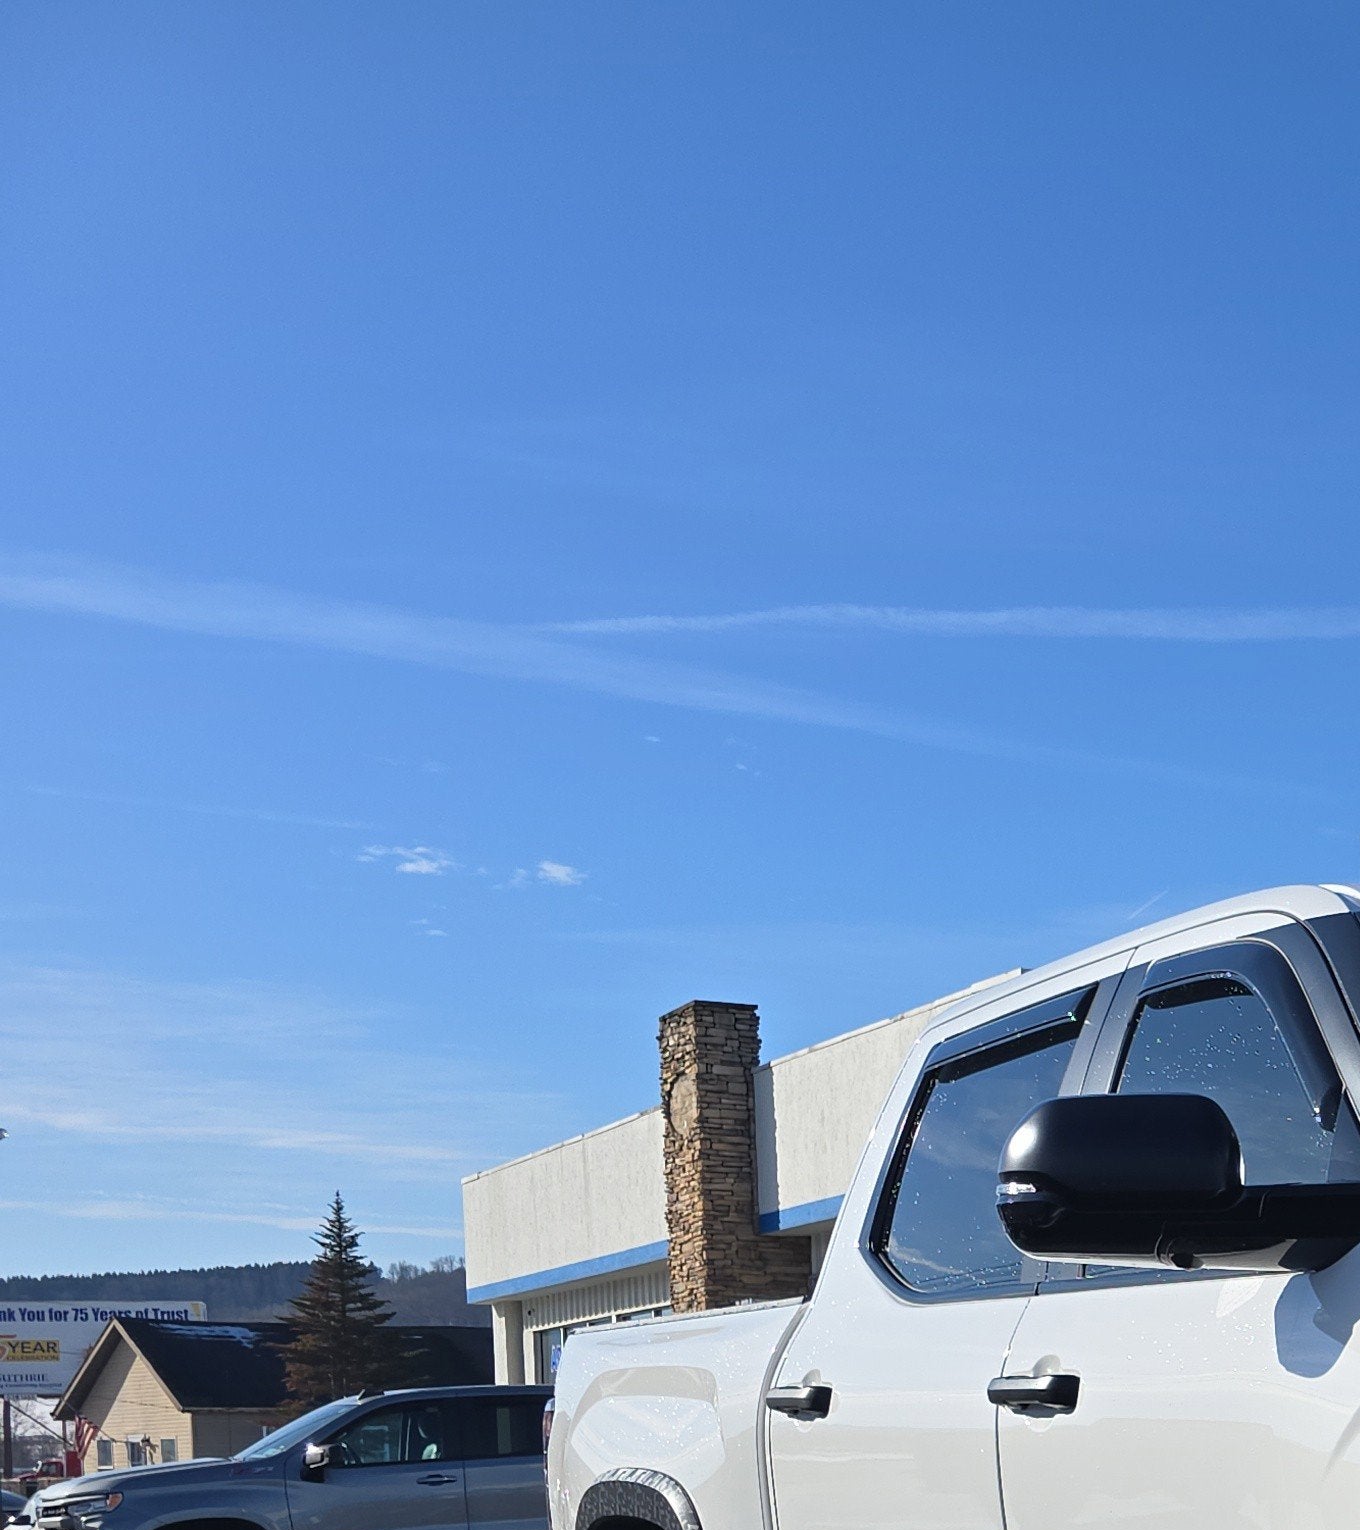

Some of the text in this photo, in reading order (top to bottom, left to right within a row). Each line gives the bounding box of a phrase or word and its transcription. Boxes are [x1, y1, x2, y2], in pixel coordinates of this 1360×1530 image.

[19, 1307, 45, 1322] You
[48, 1308, 69, 1322] for
[71, 1308, 89, 1322] 75
[91, 1308, 132, 1322] Years
[152, 1308, 189, 1321] Trust
[7, 1341, 58, 1354] YEAR
